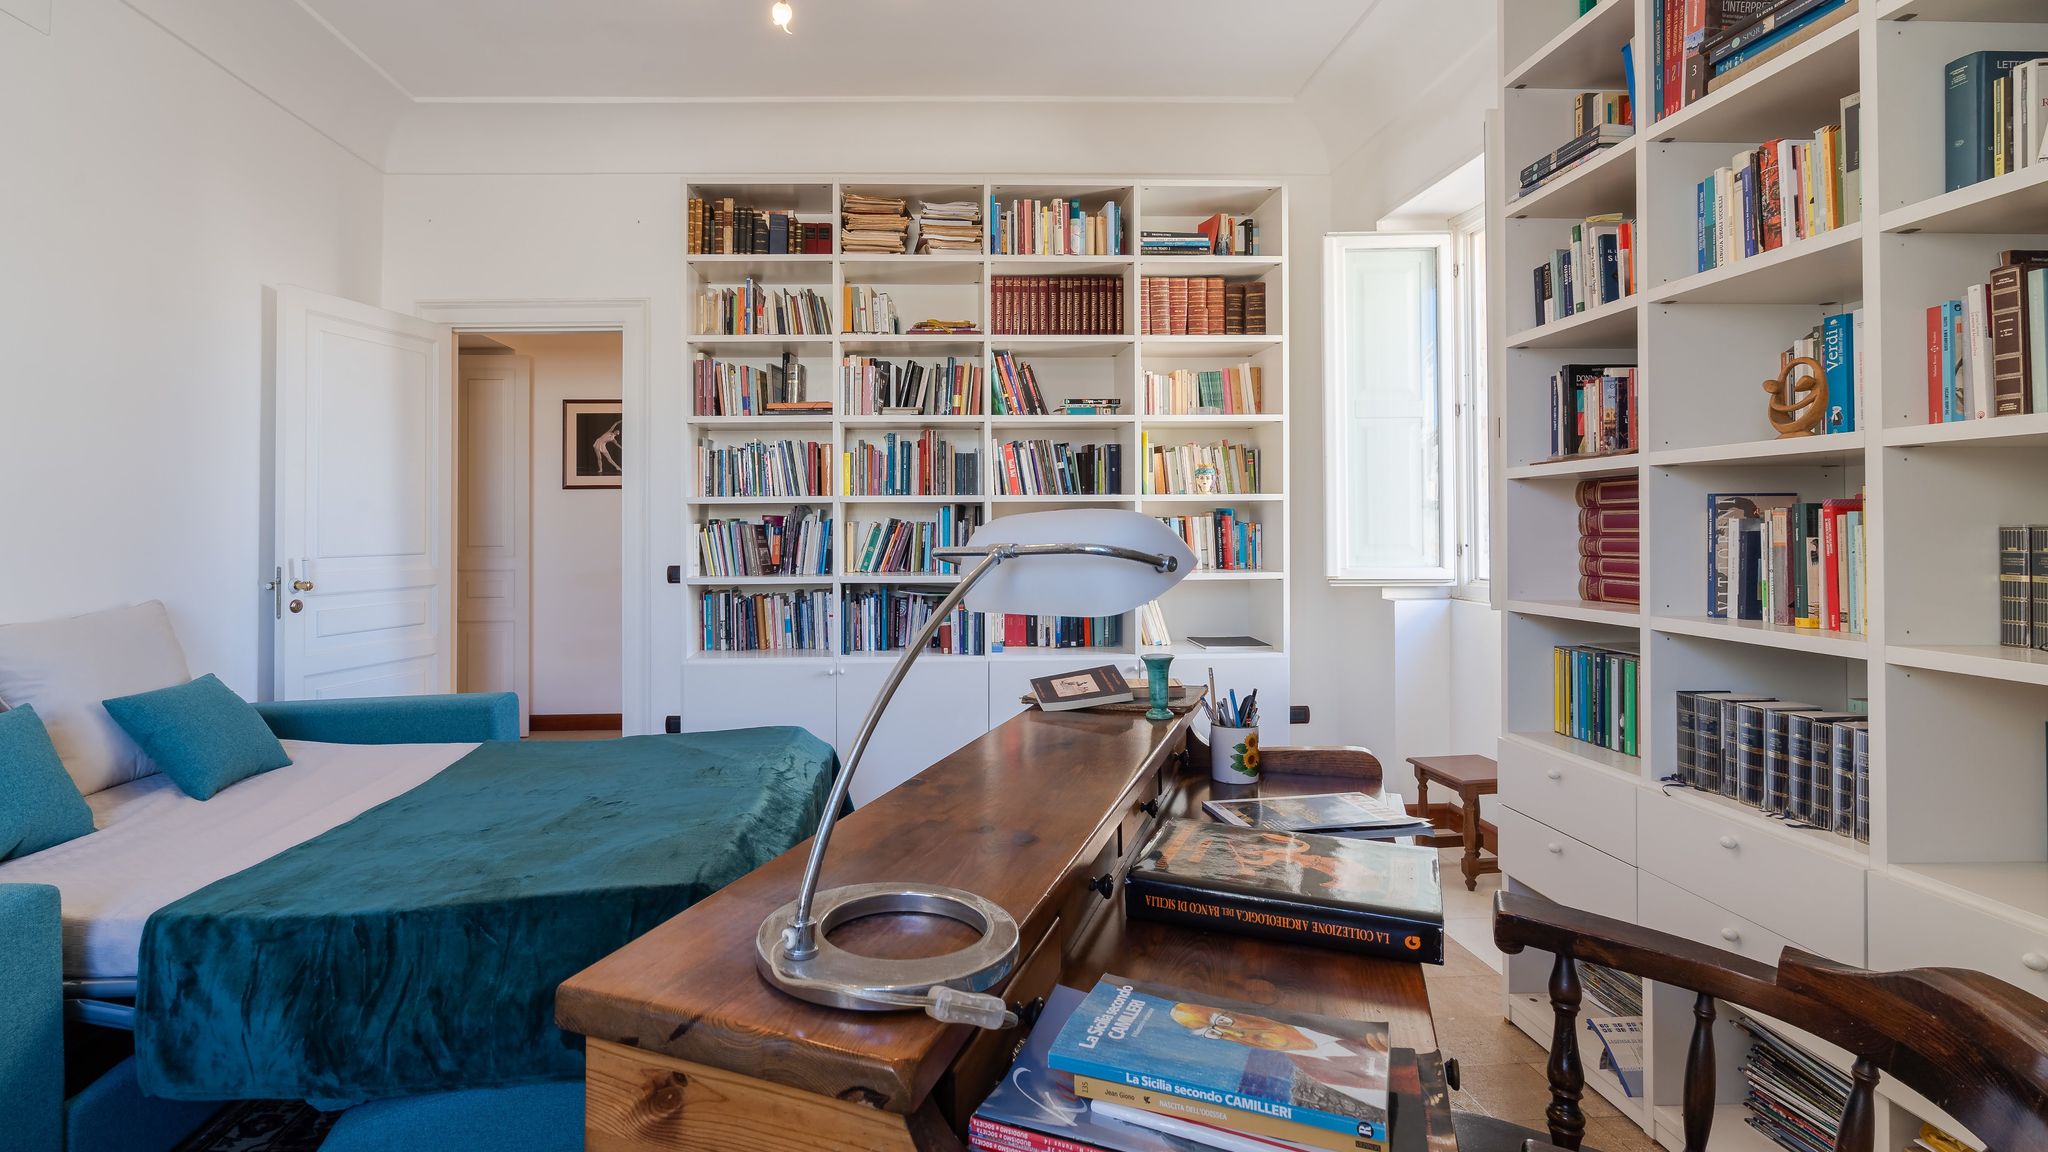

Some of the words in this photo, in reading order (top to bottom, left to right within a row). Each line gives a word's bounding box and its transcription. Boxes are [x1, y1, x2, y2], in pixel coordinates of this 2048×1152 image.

[1691, 65, 1697, 77] 3
[1825, 328, 1839, 373] Verdi
[1145, 894, 1177, 911] SICILIA
[1177, 900, 1188, 913] DI
[1189, 902, 1221, 918] BANCO
[1222, 907, 1235, 917] DEL
[1236, 908, 1309, 931] ARCHEOLOGICA
[1312, 921, 1374, 942] COLLEZIONE
[1376, 931, 1391, 945] LA
[1107, 985, 1134, 1016] secondo
[1087, 1013, 1114, 1037] Sicilia
[1107, 999, 1146, 1040] CAMILLERI
[1078, 1035, 1100, 1049] La
[1081, 1081, 1089, 1093] 135
[1104, 1088, 1118, 1099] Jean
[1118, 1090, 1136, 1101] Giono
[1126, 1072, 1139, 1085] La
[1141, 1076, 1173, 1092] Sicilia
[1174, 1083, 1223, 1103] secondo
[1225, 1094, 1293, 1119] CAMILLERI
[1159, 1099, 1185, 1113] NASCITA
[1185, 1104, 1228, 1121] DELL'ODISSEA
[999, 1125, 1029, 1139] BUDDISMO
[1002, 1133, 1032, 1147] BUDDISMO
